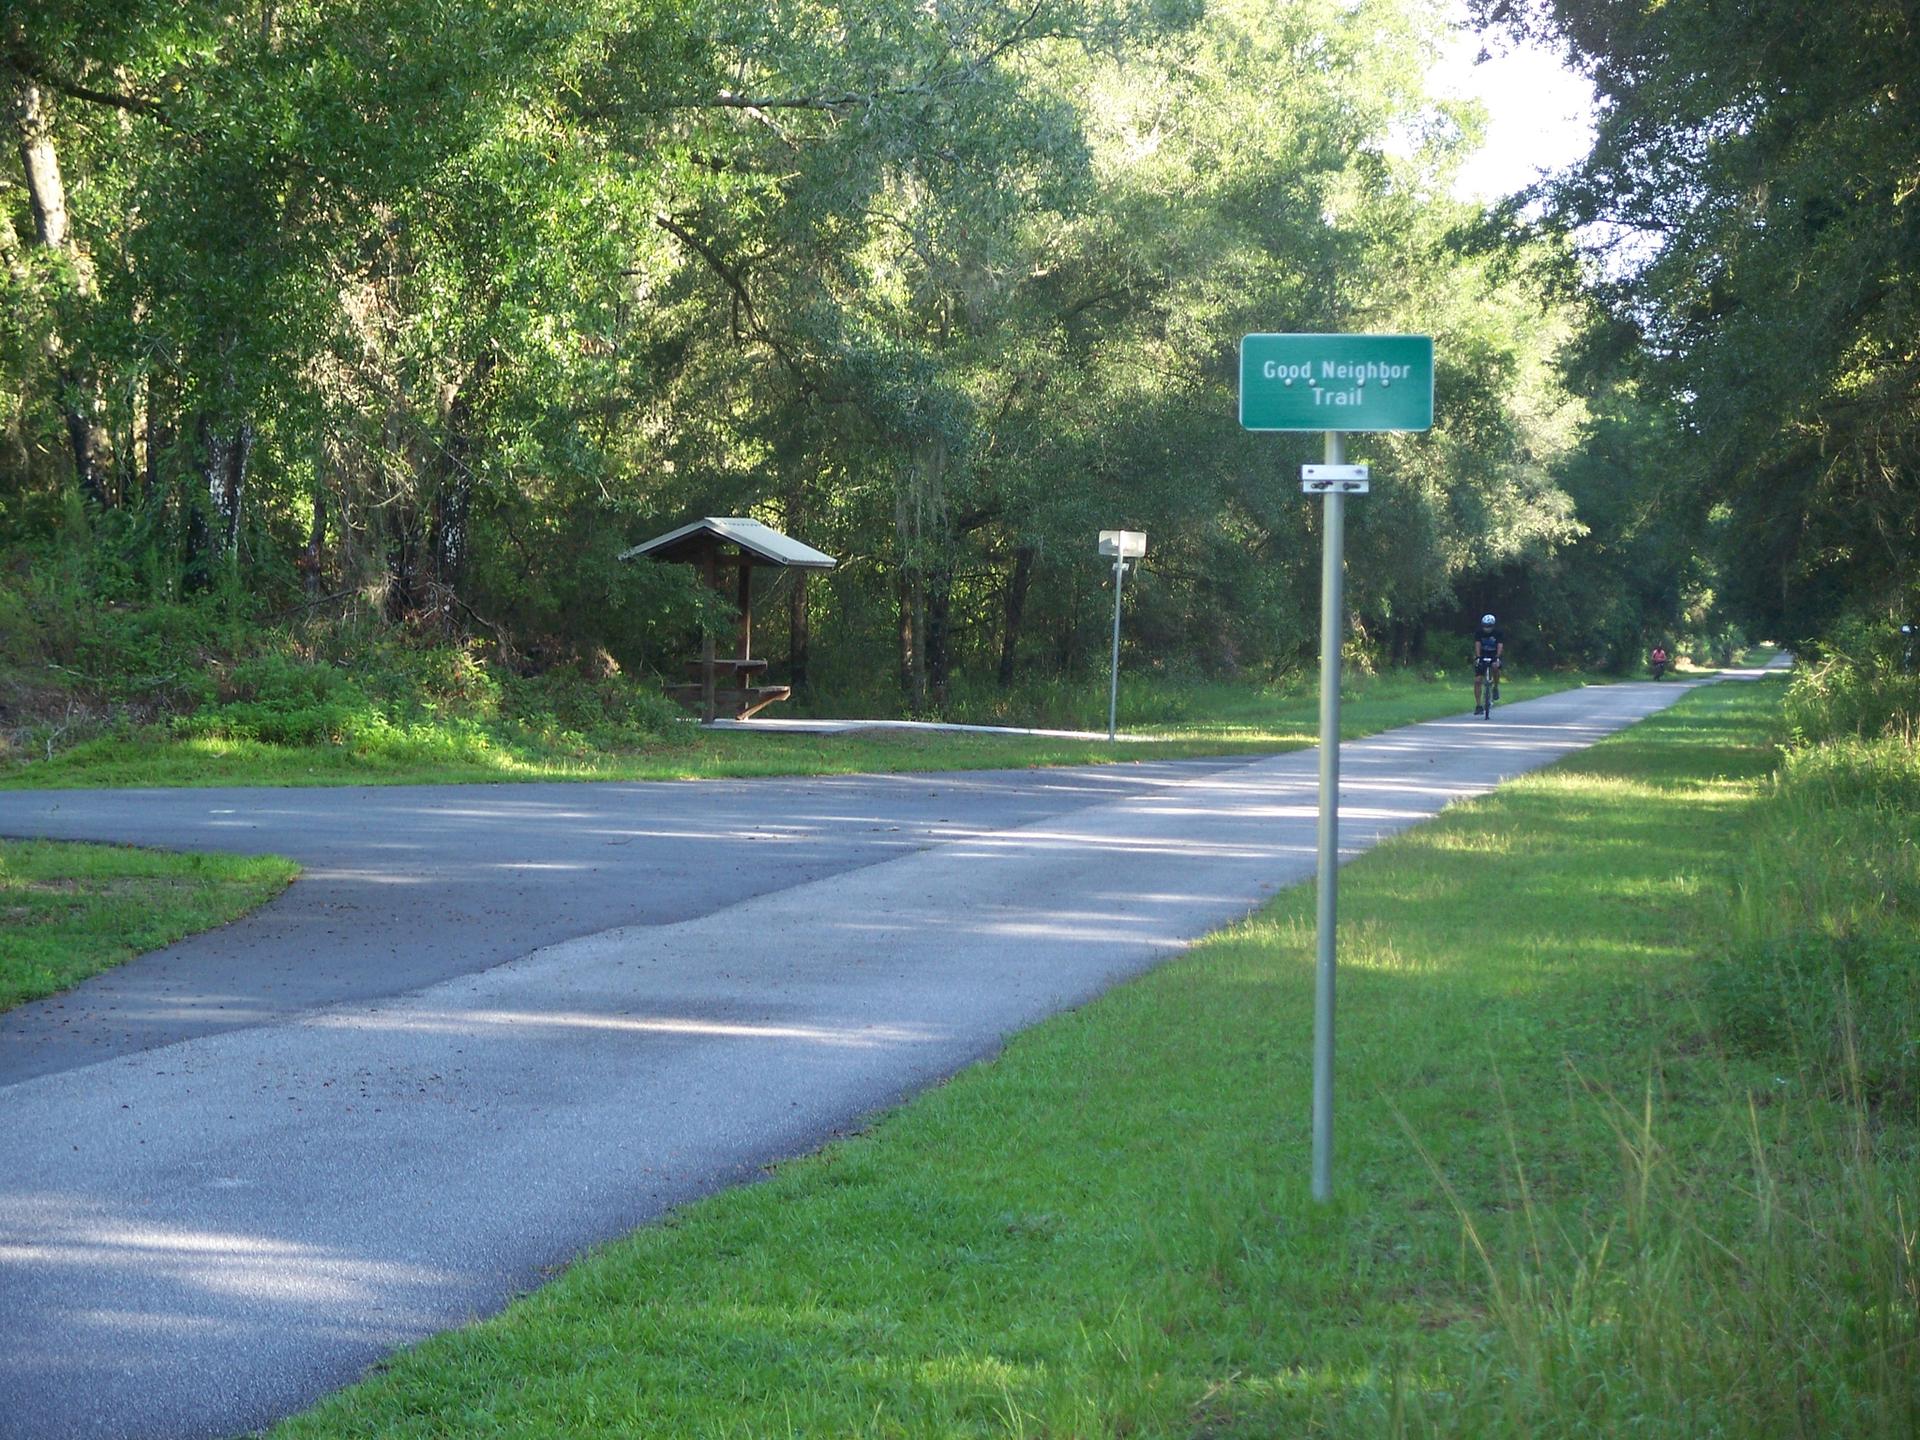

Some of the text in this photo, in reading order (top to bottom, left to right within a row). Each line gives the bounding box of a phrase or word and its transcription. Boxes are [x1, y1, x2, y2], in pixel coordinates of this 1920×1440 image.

[1264, 361, 1411, 384] Good Neighbor
[1312, 388, 1362, 405] Trail
